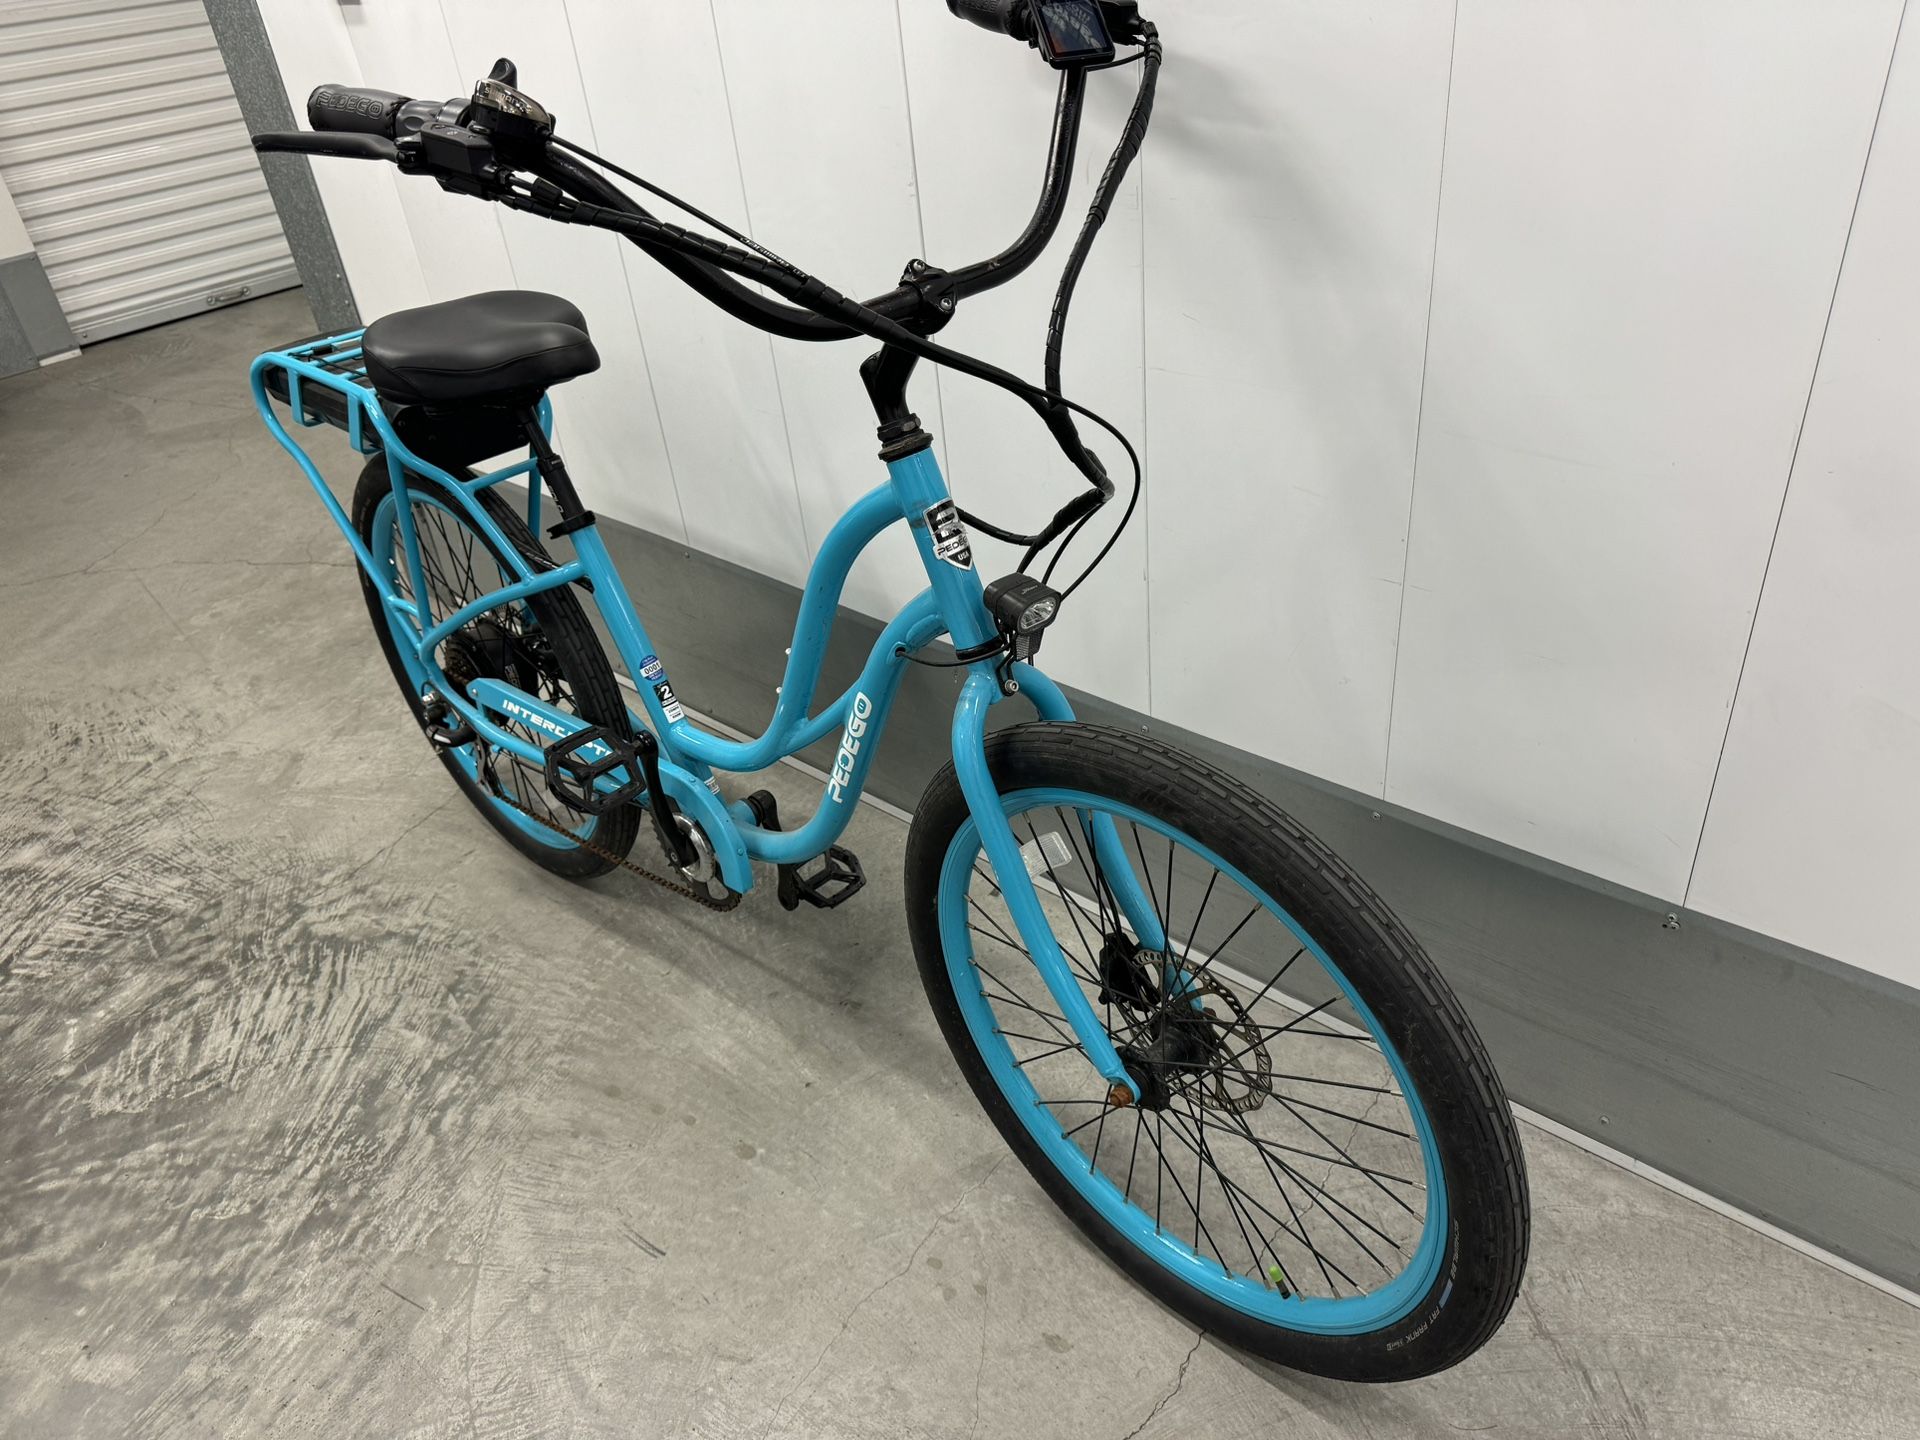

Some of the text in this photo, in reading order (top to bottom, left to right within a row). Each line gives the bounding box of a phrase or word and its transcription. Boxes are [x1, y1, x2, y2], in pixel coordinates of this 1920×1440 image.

[937, 535, 968, 556] PEDEG
[643, 662, 660, 675] 0001
[660, 685, 673, 700] 2
[827, 691, 872, 803] PEDEGO
[1405, 1305, 1440, 1344] FAT FRANK
